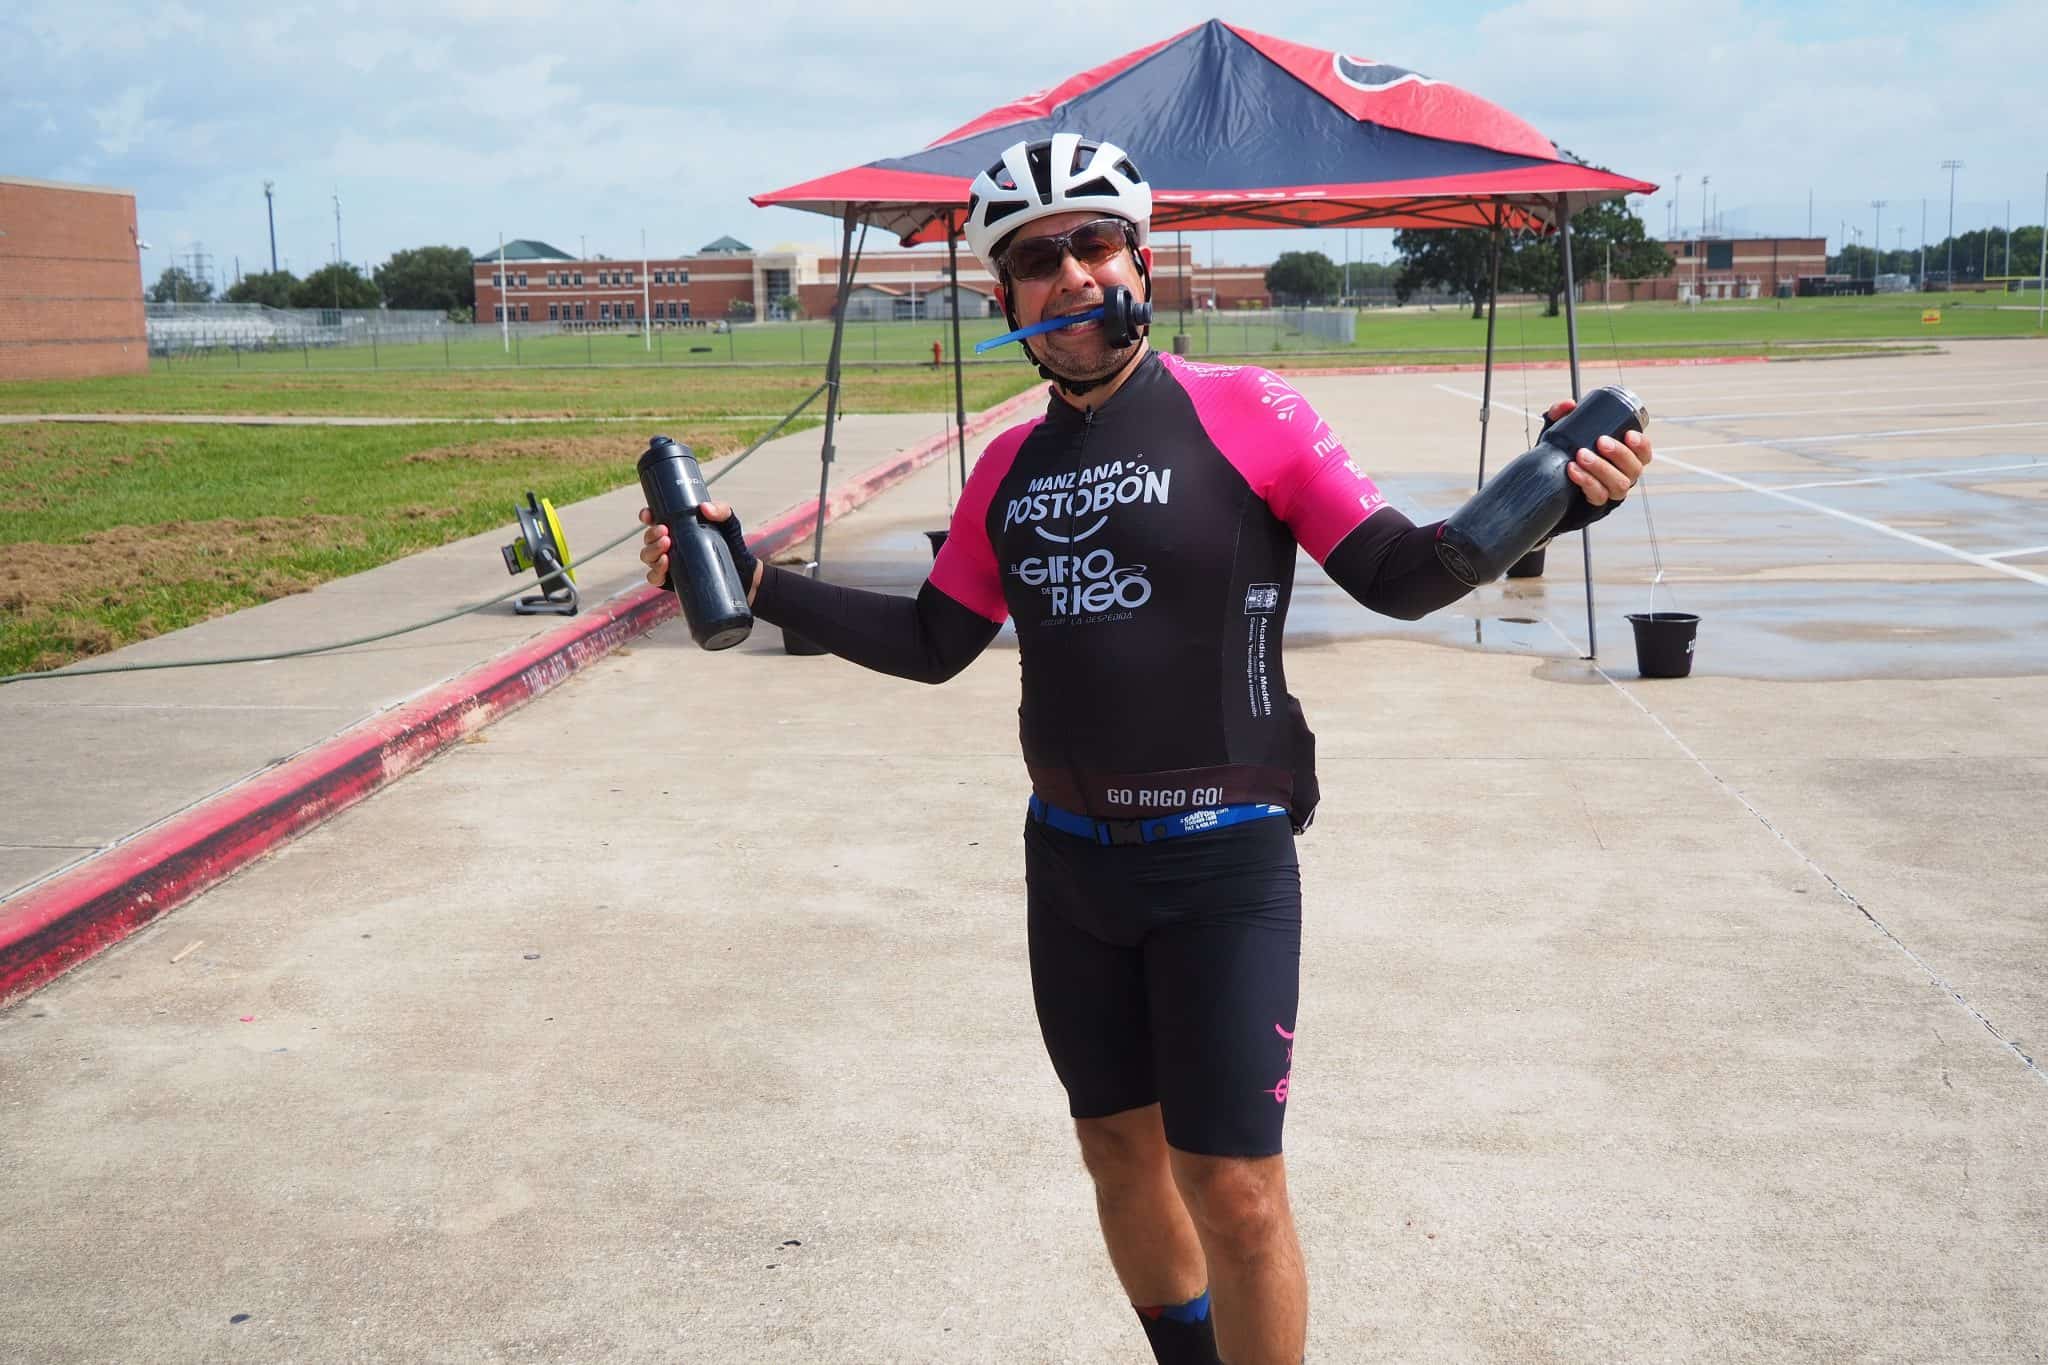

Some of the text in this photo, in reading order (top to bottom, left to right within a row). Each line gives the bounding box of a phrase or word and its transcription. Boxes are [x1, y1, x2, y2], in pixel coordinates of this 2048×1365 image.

[1028, 460, 1123, 493] MANZANA
[1004, 468, 1172, 533] POSTOBON
[1018, 549, 1115, 585] GIRO
[1052, 575, 1152, 616] RIGO
[1258, 661, 1267, 674] de
[1107, 787, 1223, 807] GO RIGO GO!
